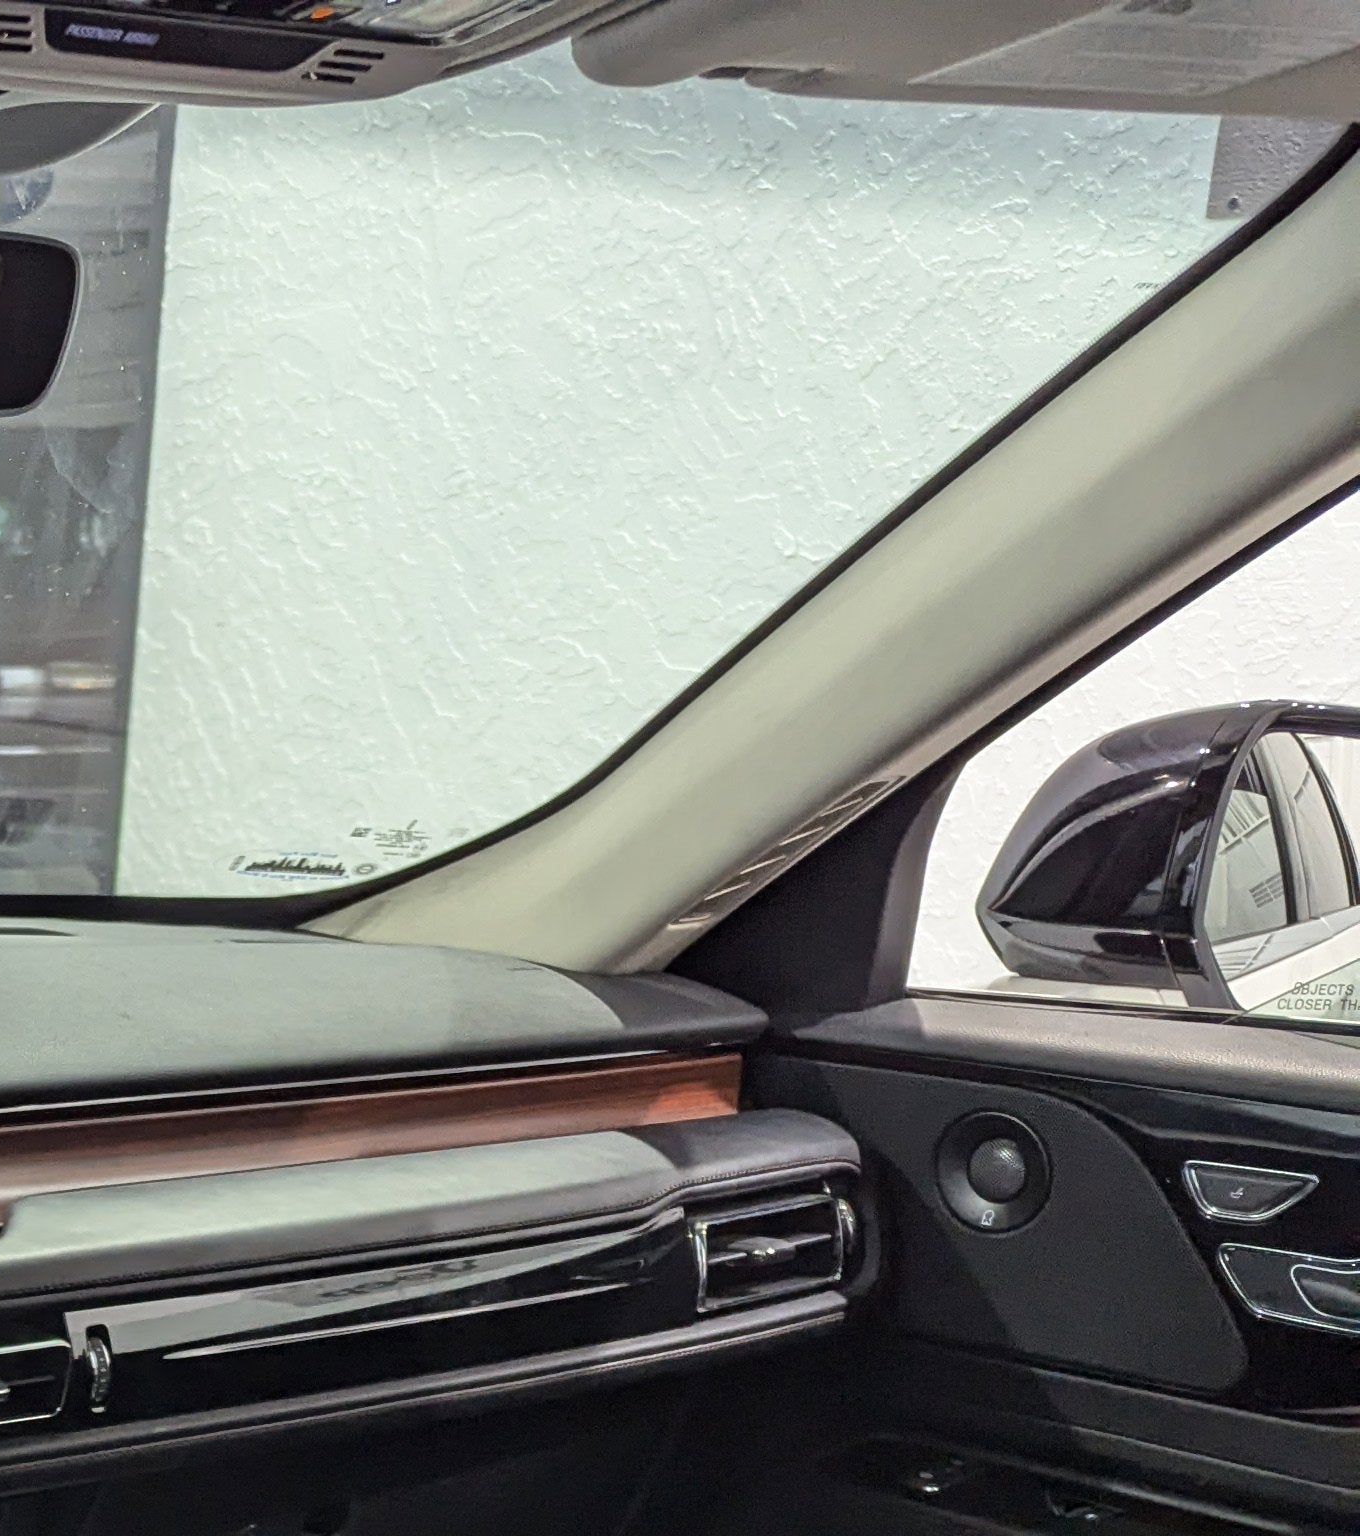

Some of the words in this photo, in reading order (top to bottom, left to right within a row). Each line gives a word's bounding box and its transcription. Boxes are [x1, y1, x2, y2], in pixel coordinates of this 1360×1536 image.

[1291, 982, 1355, 996] OBJECTS
[1277, 998, 1332, 1010] CLOSER
[1340, 999, 1360, 1011] TH
